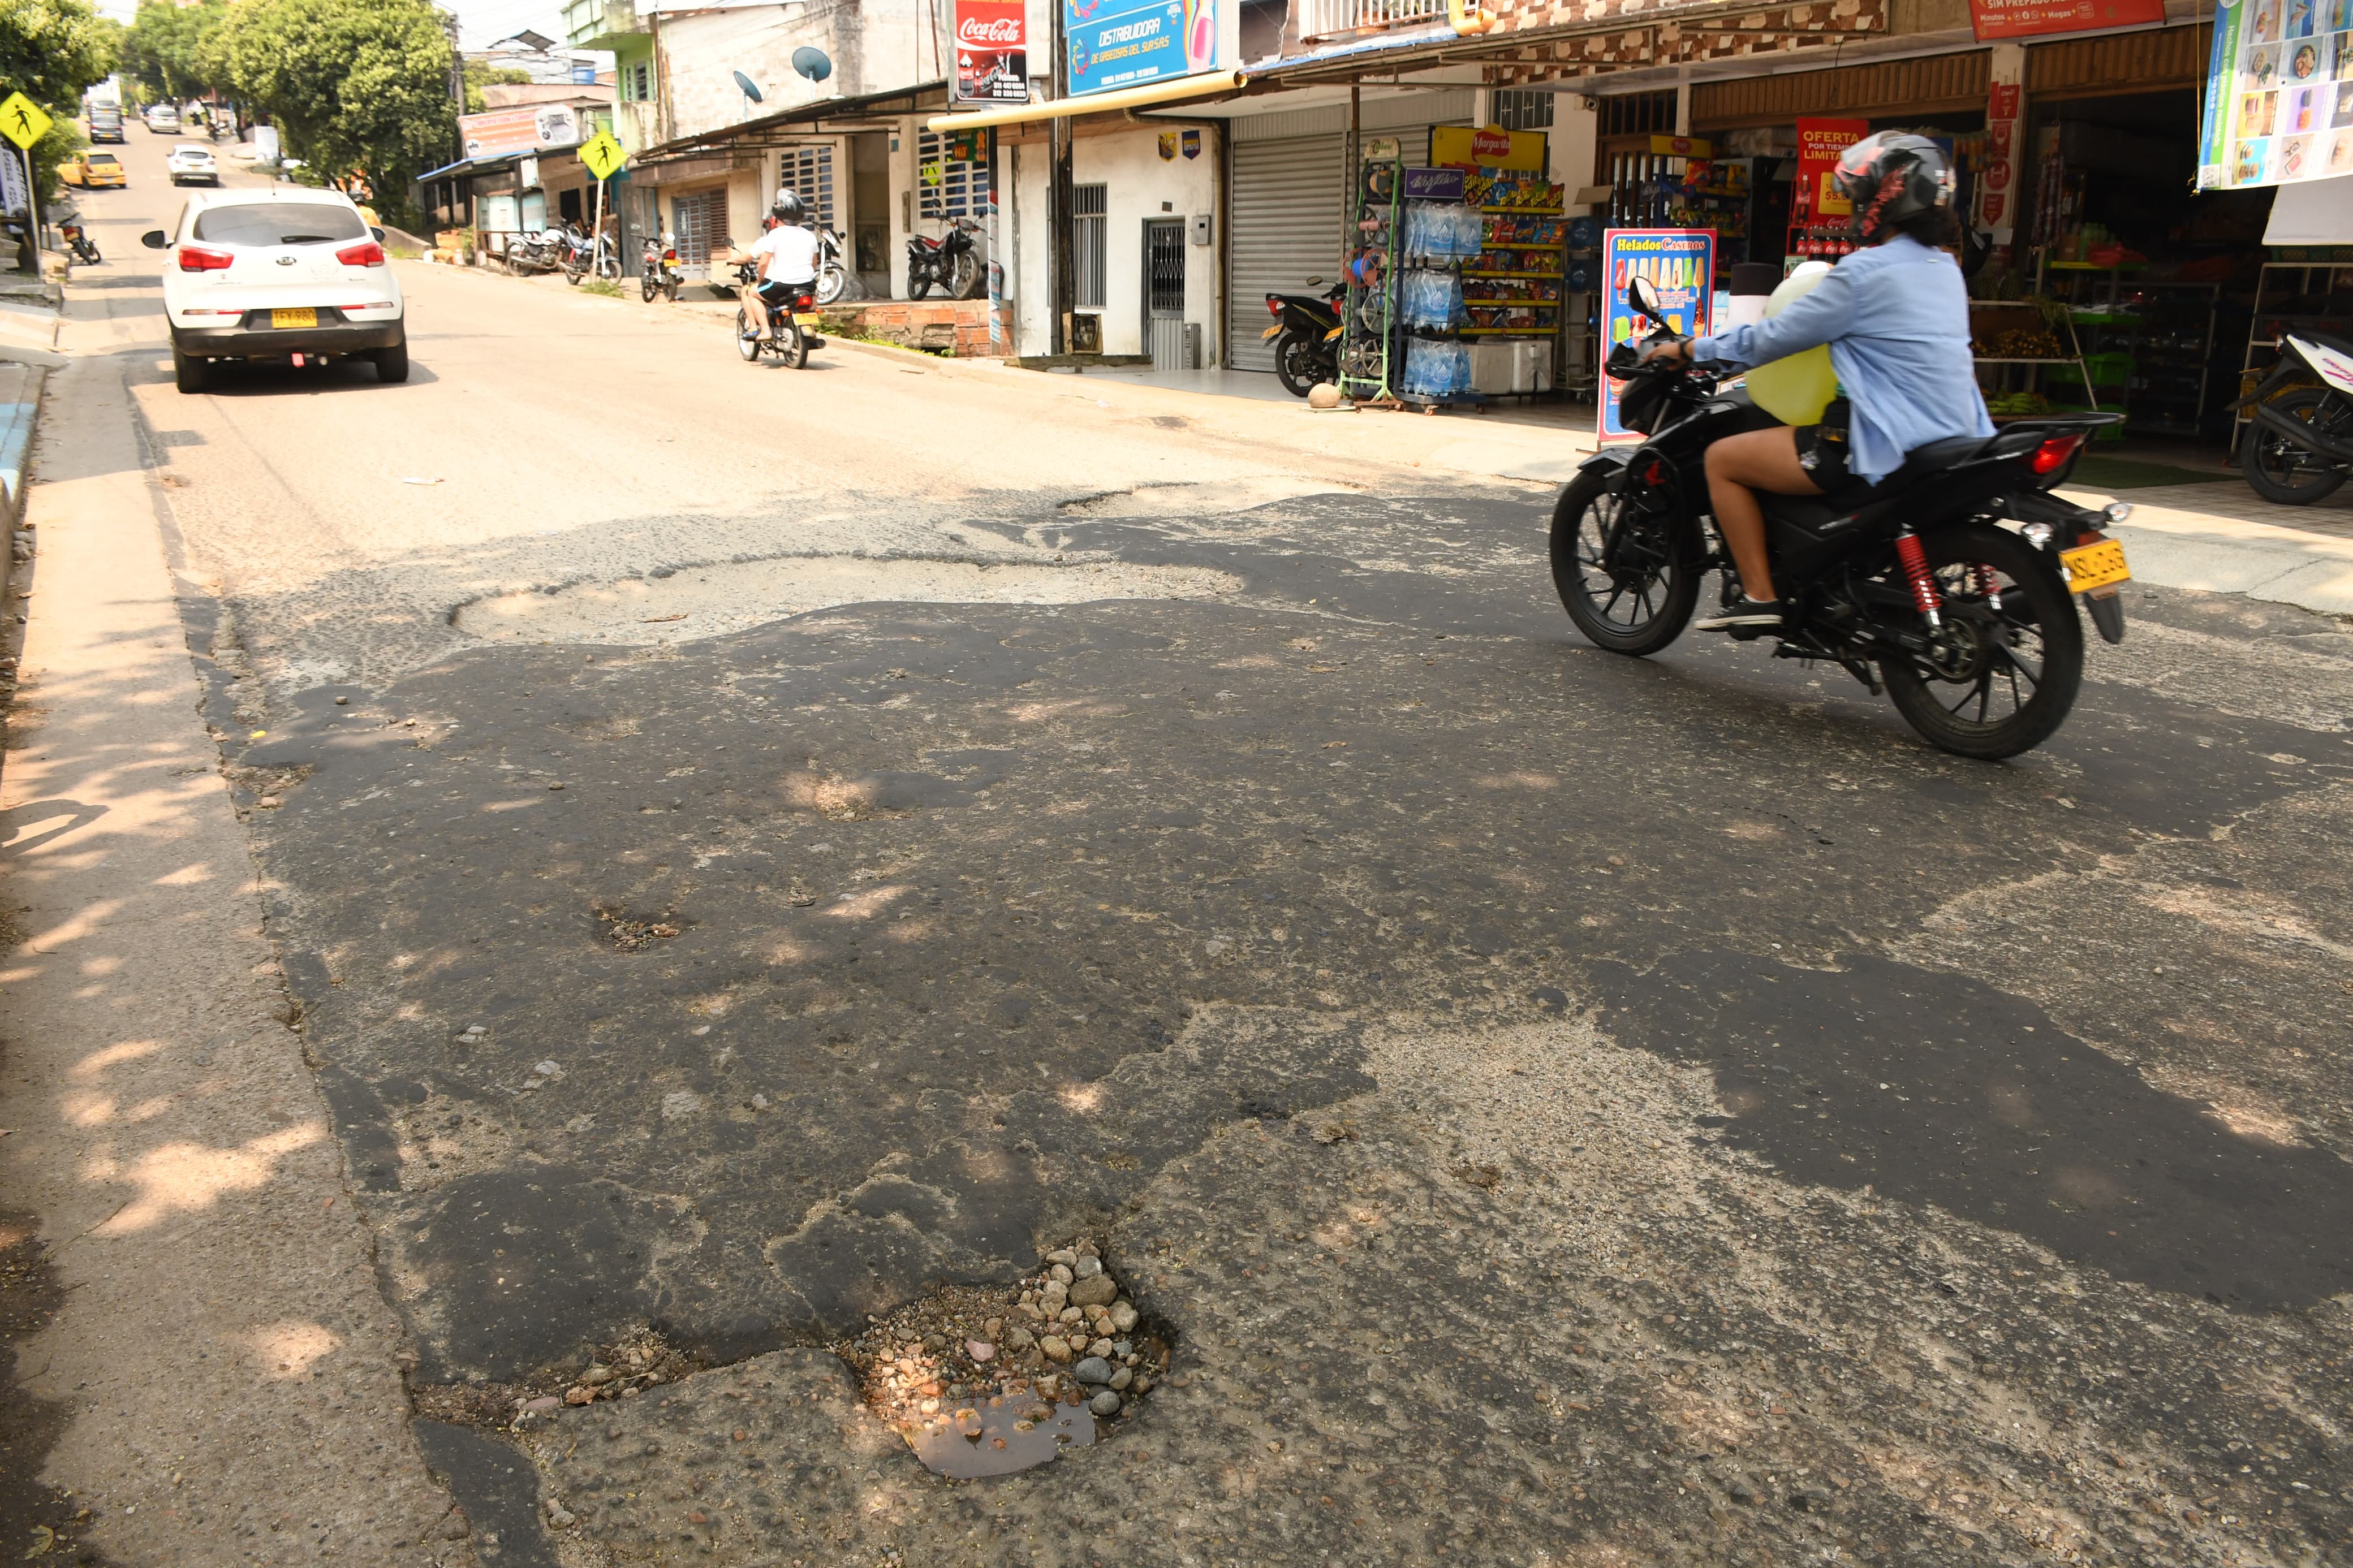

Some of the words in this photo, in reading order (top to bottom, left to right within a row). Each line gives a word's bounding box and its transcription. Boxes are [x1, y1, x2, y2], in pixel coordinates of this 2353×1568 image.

[1987, 0, 2004, 9] SIM
[1980, 12, 2005, 21] Minutos
[2048, 10, 2071, 19] Megas
[960, 17, 1022, 42] Coca-Cola
[1098, 18, 1161, 47] DISTRIBUIDORA
[1091, 54, 1098, 65] DE
[1099, 47, 1128, 63] GASEOSAS
[1128, 44, 1140, 55] DEL
[1472, 136, 1510, 153] Margarita
[1803, 131, 1860, 144] OFERTA
[1617, 239, 1661, 251] Helados
